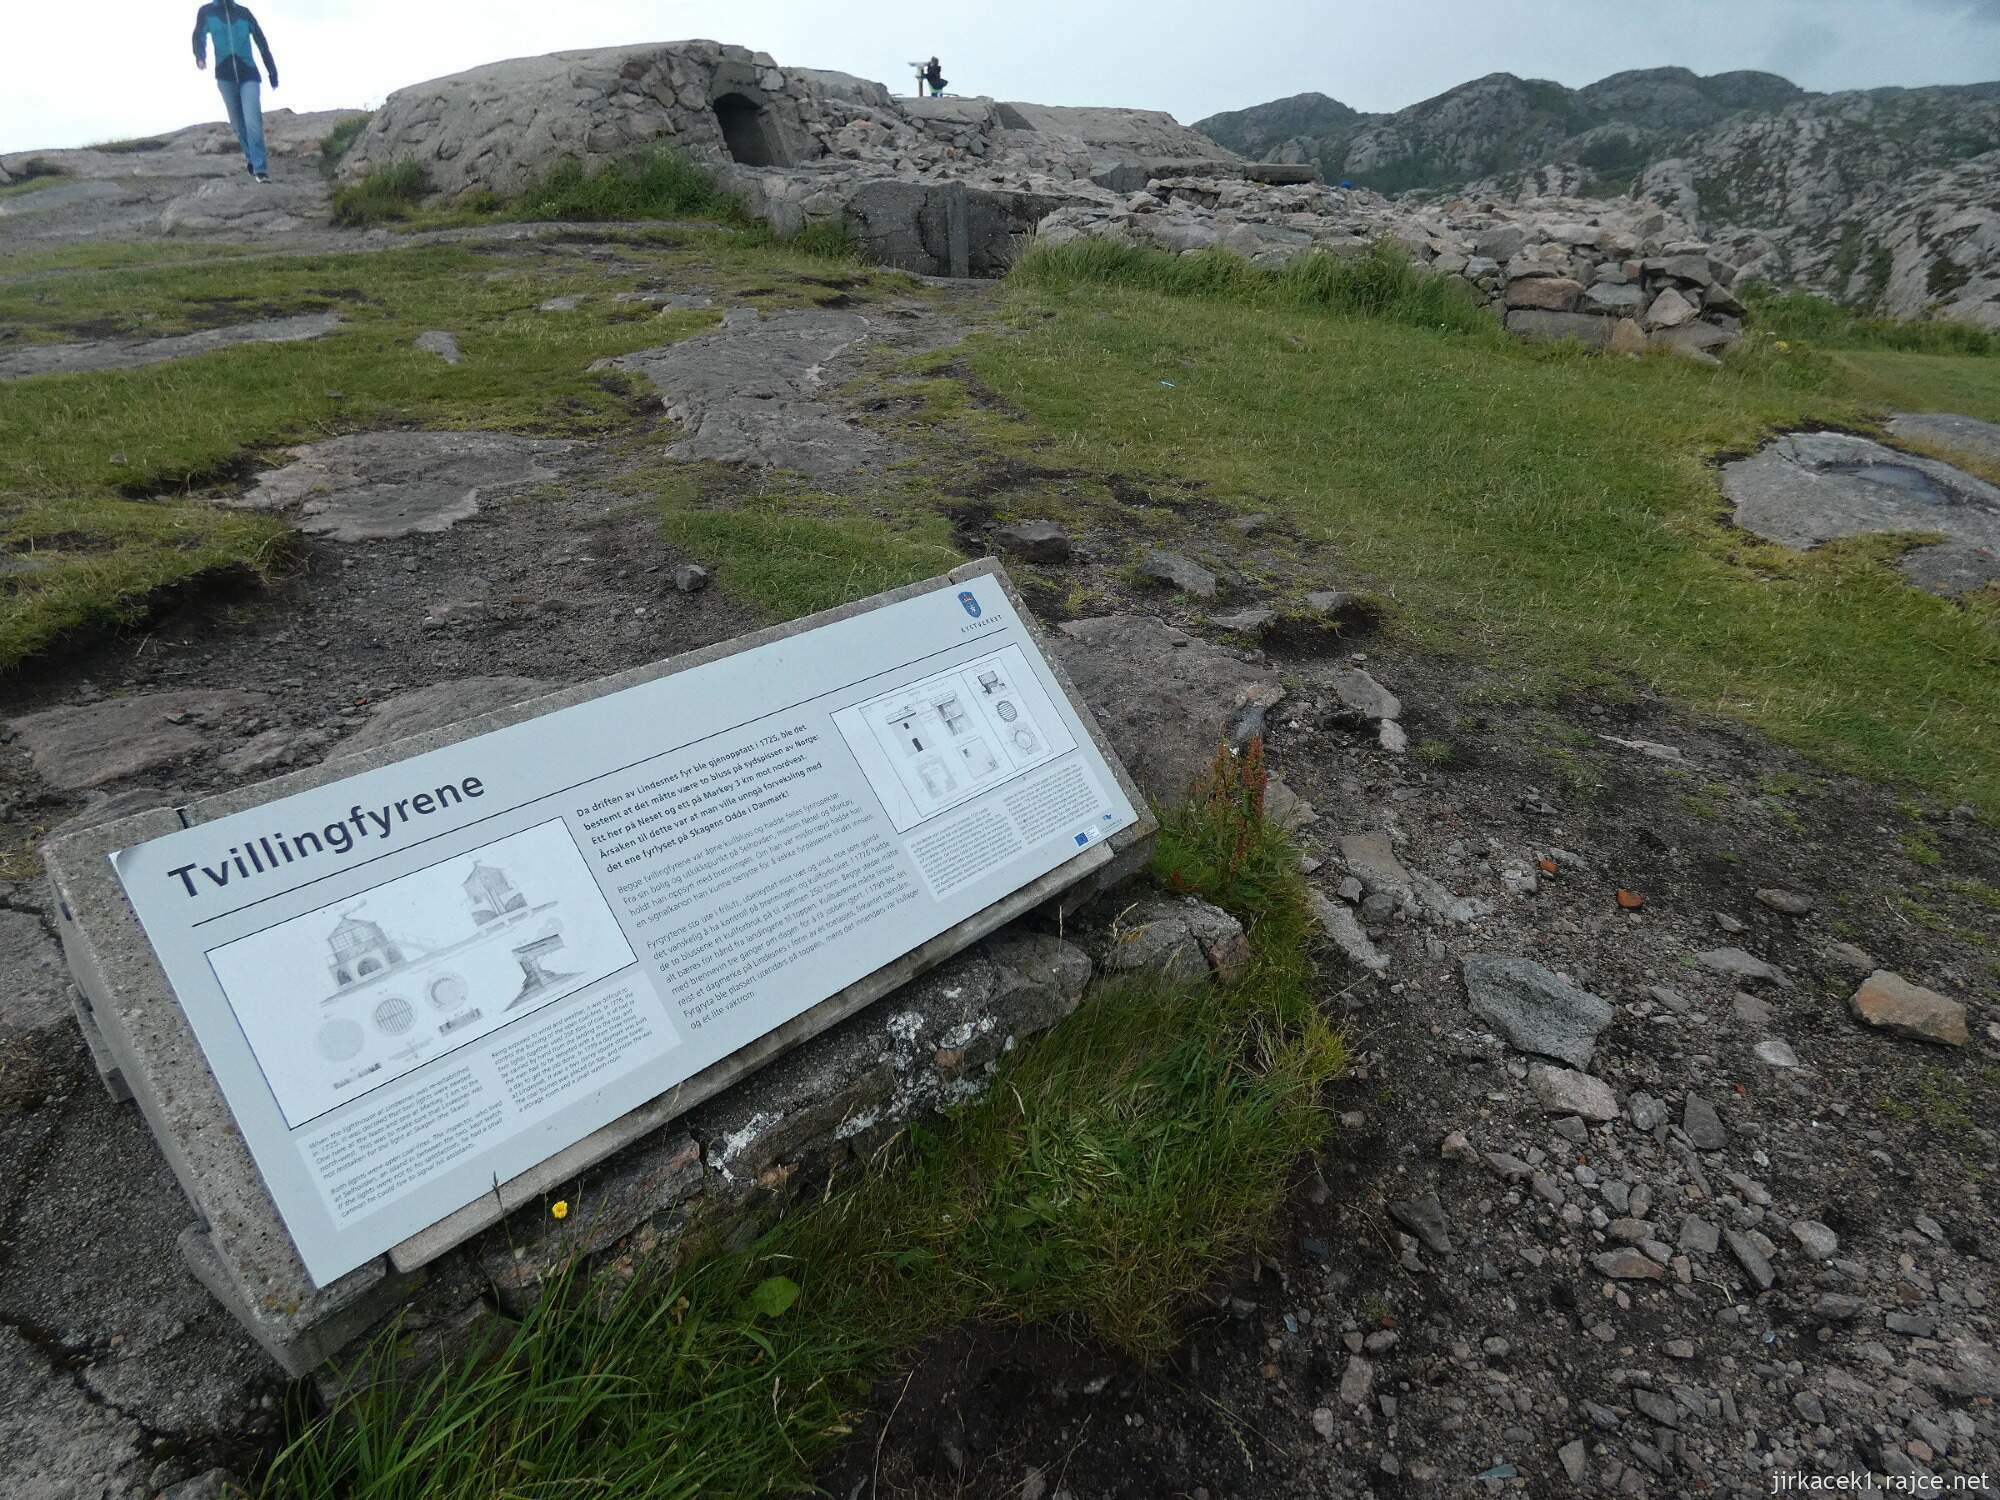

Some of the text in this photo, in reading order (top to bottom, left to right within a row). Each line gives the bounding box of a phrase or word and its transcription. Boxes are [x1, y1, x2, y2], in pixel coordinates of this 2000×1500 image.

[584, 812, 622, 830] bestemt
[634, 801, 649, 810] det
[652, 791, 676, 803] måtte
[679, 782, 698, 793] være
[710, 770, 731, 780] bluss
[733, 764, 743, 773] på
[744, 749, 784, 767] sydspissen
[591, 796, 623, 810] driften
[637, 774, 679, 793] Lindesnes
[680, 769, 693, 777] fyr
[709, 745, 754, 767] gjenopptatt
[592, 835, 606, 844] Ett
[607, 829, 623, 838] her
[625, 822, 636, 833] på
[638, 812, 663, 825] Neset
[678, 801, 690, 809] ett
[692, 795, 702, 806] på
[703, 784, 735, 798] Markøy
[756, 768, 771, 777] mot
[598, 840, 636, 858] Årsaken
[638, 834, 648, 842] til
[649, 825, 672, 837] dette
[674, 819, 688, 827] var
[701, 806, 718, 816] man
[720, 798, 736, 808] ville
[738, 786, 762, 800] unngå
[763, 770, 806, 789] forveksling
[806, 762, 822, 772] med
[168, 775, 485, 897] Tvillingfyrene
[606, 862, 622, 872] det
[625, 854, 641, 864] ene
[643, 839, 676, 857] fyrlyset
[678, 833, 688, 844] på
[690, 820, 724, 836] Skagens
[725, 810, 746, 821] Odde
